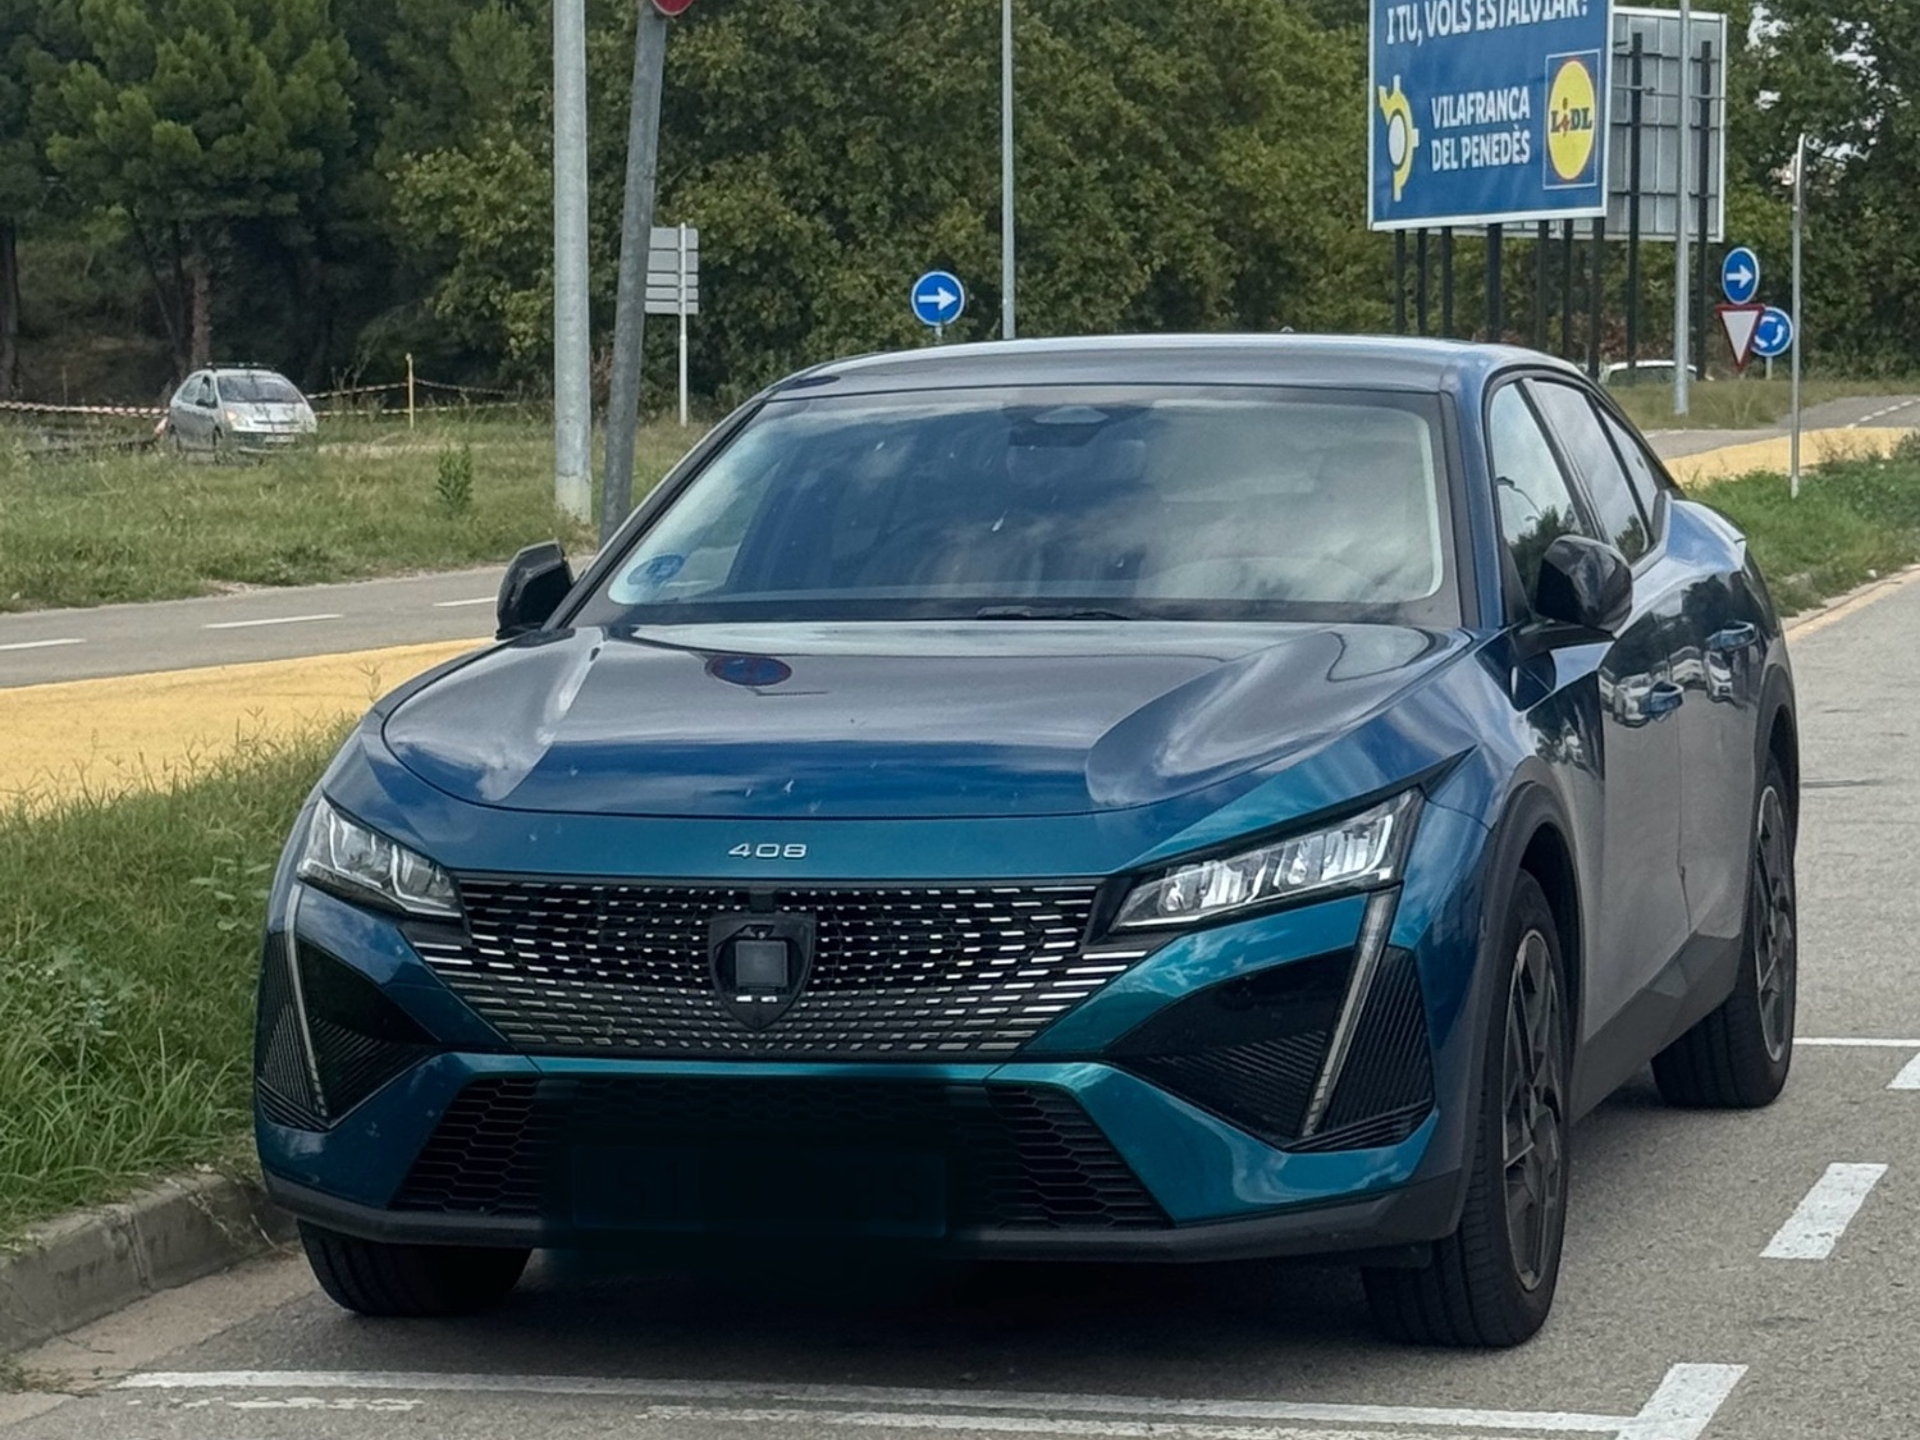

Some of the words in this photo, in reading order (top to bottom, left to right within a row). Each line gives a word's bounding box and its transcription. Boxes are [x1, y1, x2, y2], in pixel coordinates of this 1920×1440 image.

[1386, 8, 1395, 44] I
[1397, 4, 1423, 46] TU,
[1425, 0, 1470, 38] VOLS
[1431, 86, 1531, 129] VILAFRANCA
[1431, 136, 1459, 172] DEL
[1460, 123, 1531, 169] PENEDÈS
[727, 842, 807, 858] 408
